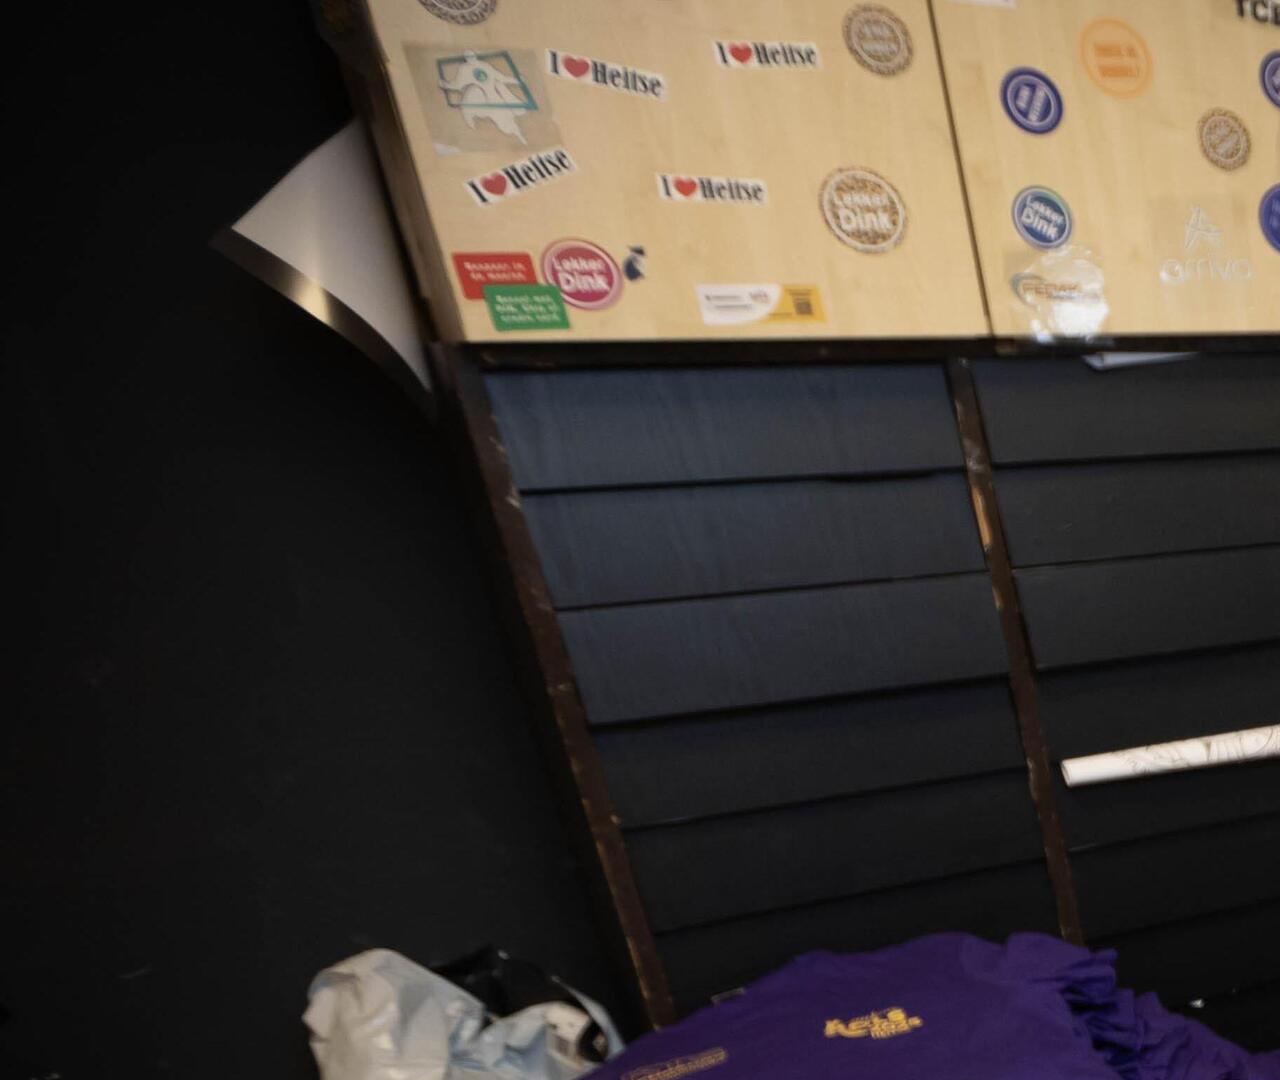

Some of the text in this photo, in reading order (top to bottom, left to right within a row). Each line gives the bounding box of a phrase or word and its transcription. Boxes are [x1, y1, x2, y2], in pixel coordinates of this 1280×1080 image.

[716, 42, 817, 66] I Heitse
[550, 51, 663, 97] I Heitse
[467, 149, 572, 203] I Heitse
[660, 174, 765, 202] I Heitse
[558, 271, 610, 293] Dink
